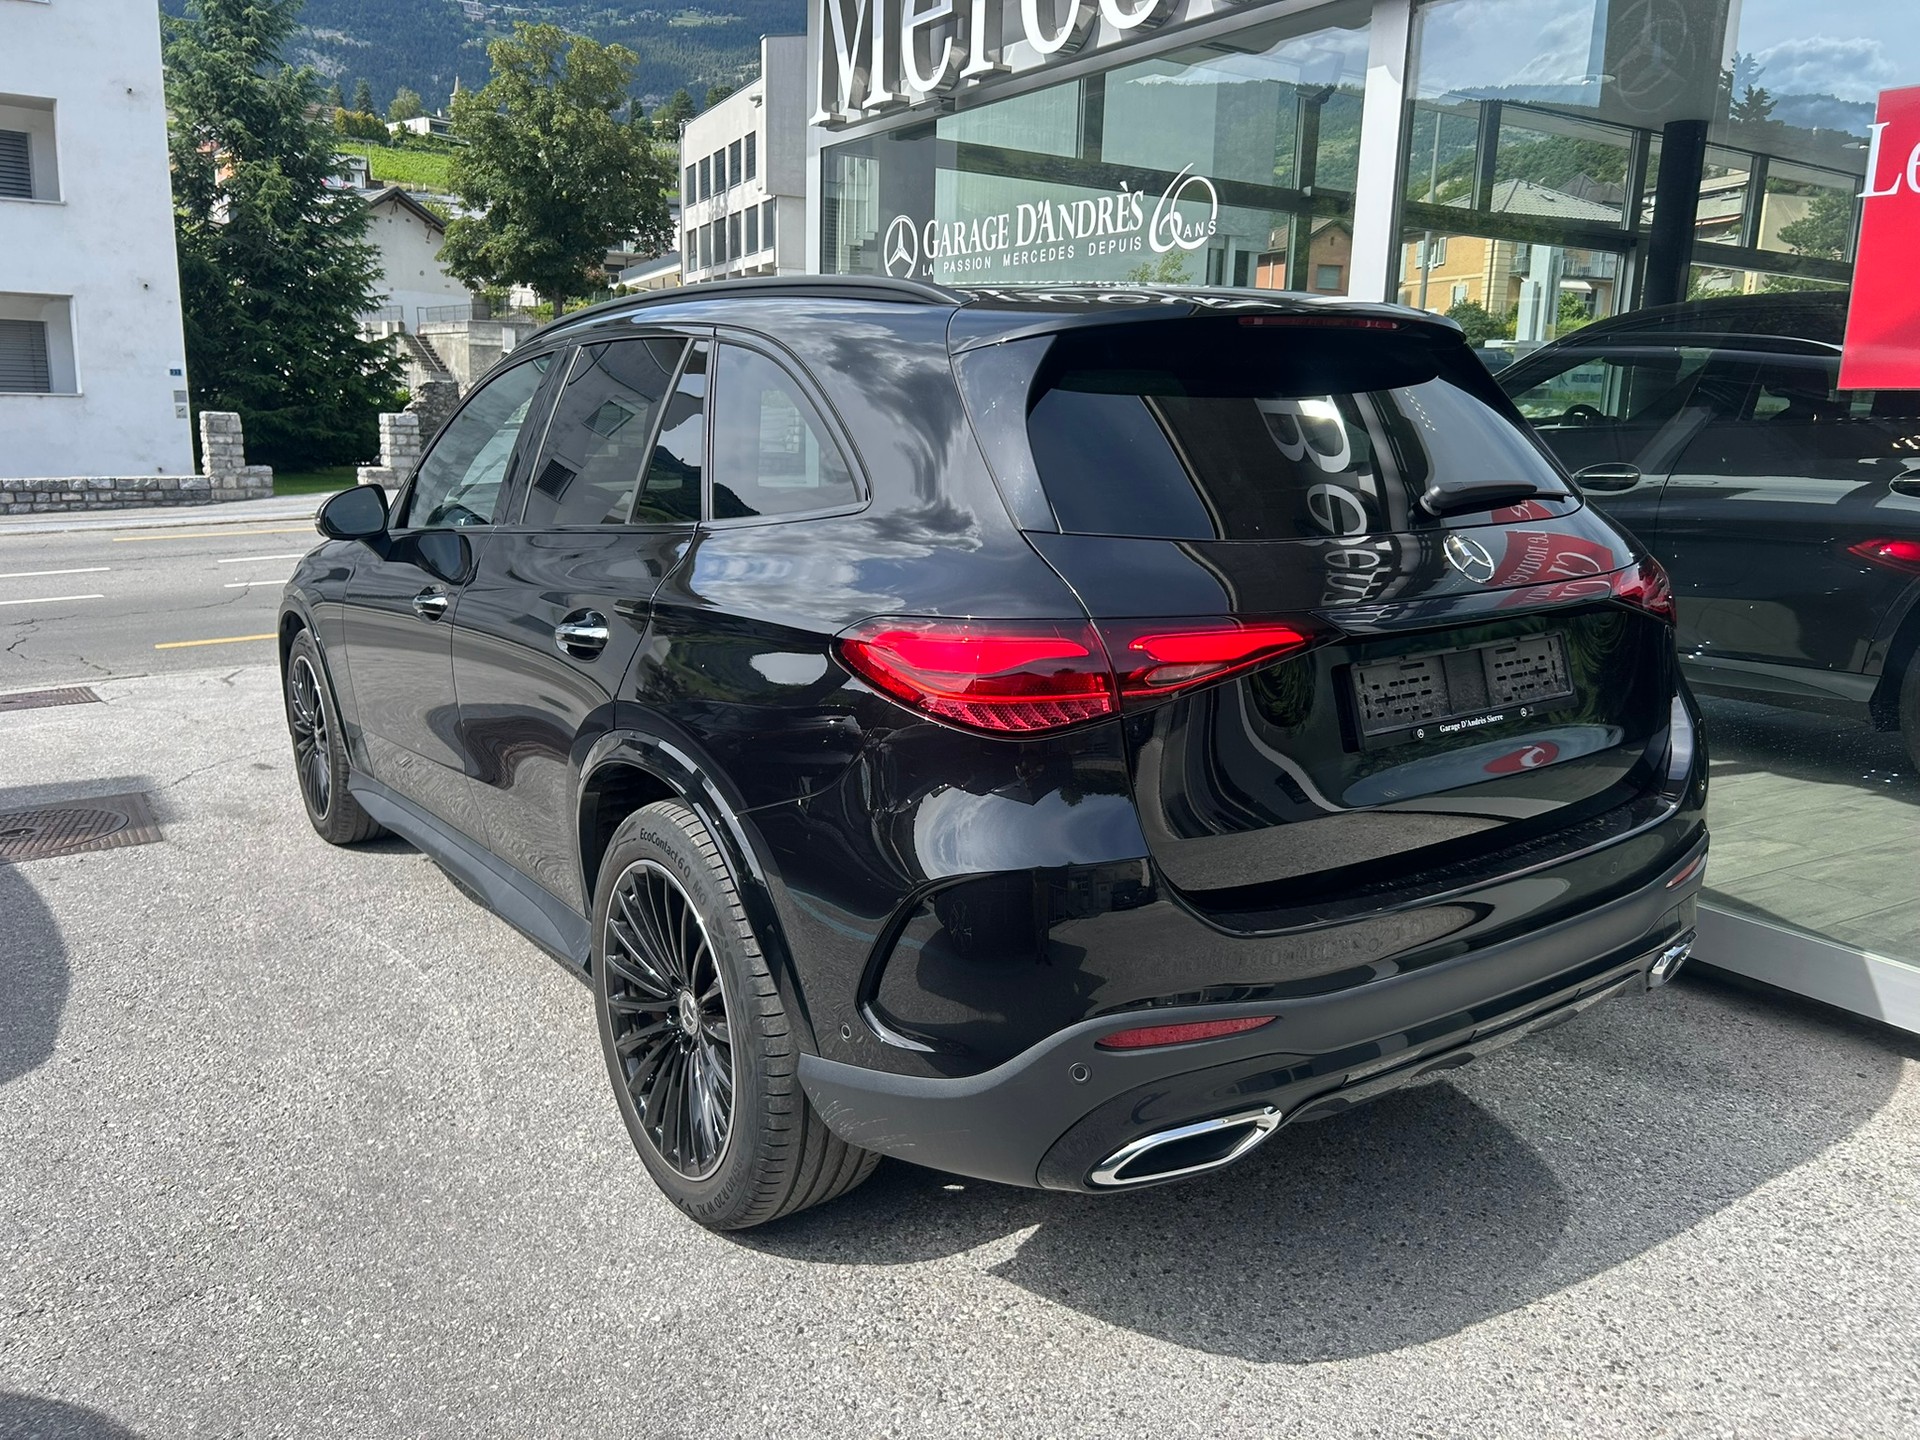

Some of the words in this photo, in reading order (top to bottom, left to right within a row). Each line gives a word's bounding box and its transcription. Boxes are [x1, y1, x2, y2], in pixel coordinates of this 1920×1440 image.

[922, 263, 934, 276] LA
[943, 256, 991, 274] PASSION
[1003, 245, 1075, 267] MERCEDES
[1089, 236, 1142, 255] DEPUIS
[1148, 162, 1218, 253] 60
[1183, 219, 1217, 238] ANS
[922, 213, 1010, 259] GARAGE
[1015, 180, 1144, 247] D'ANDRÈS
[1439, 722, 1460, 732] Garage
[1486, 714, 1503, 723] Sierre
[640, 827, 679, 863] EcoContact
[677, 857, 685, 870] 6
